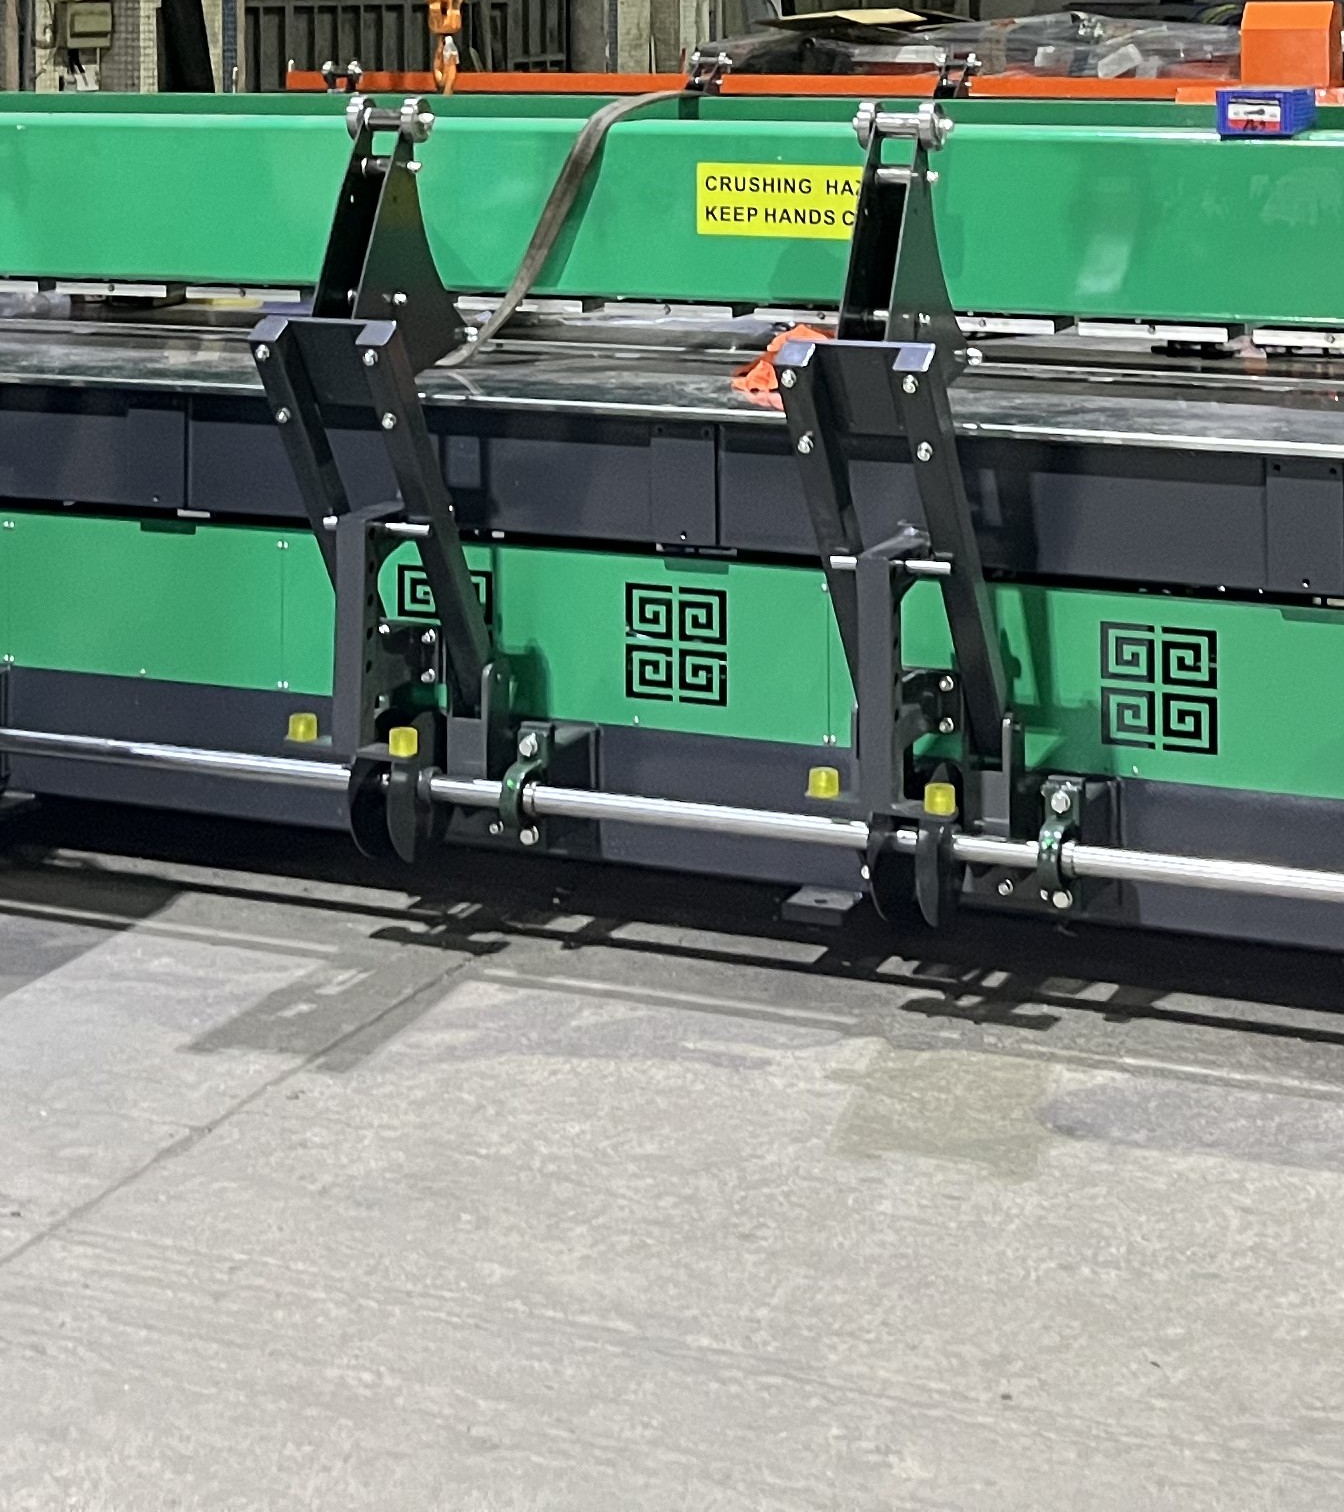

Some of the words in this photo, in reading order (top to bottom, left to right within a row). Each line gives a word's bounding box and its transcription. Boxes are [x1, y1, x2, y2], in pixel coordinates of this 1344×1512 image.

[705, 175, 812, 194] CRUSHING
[705, 206, 757, 223] KEEP
[764, 208, 836, 226] HANDS
